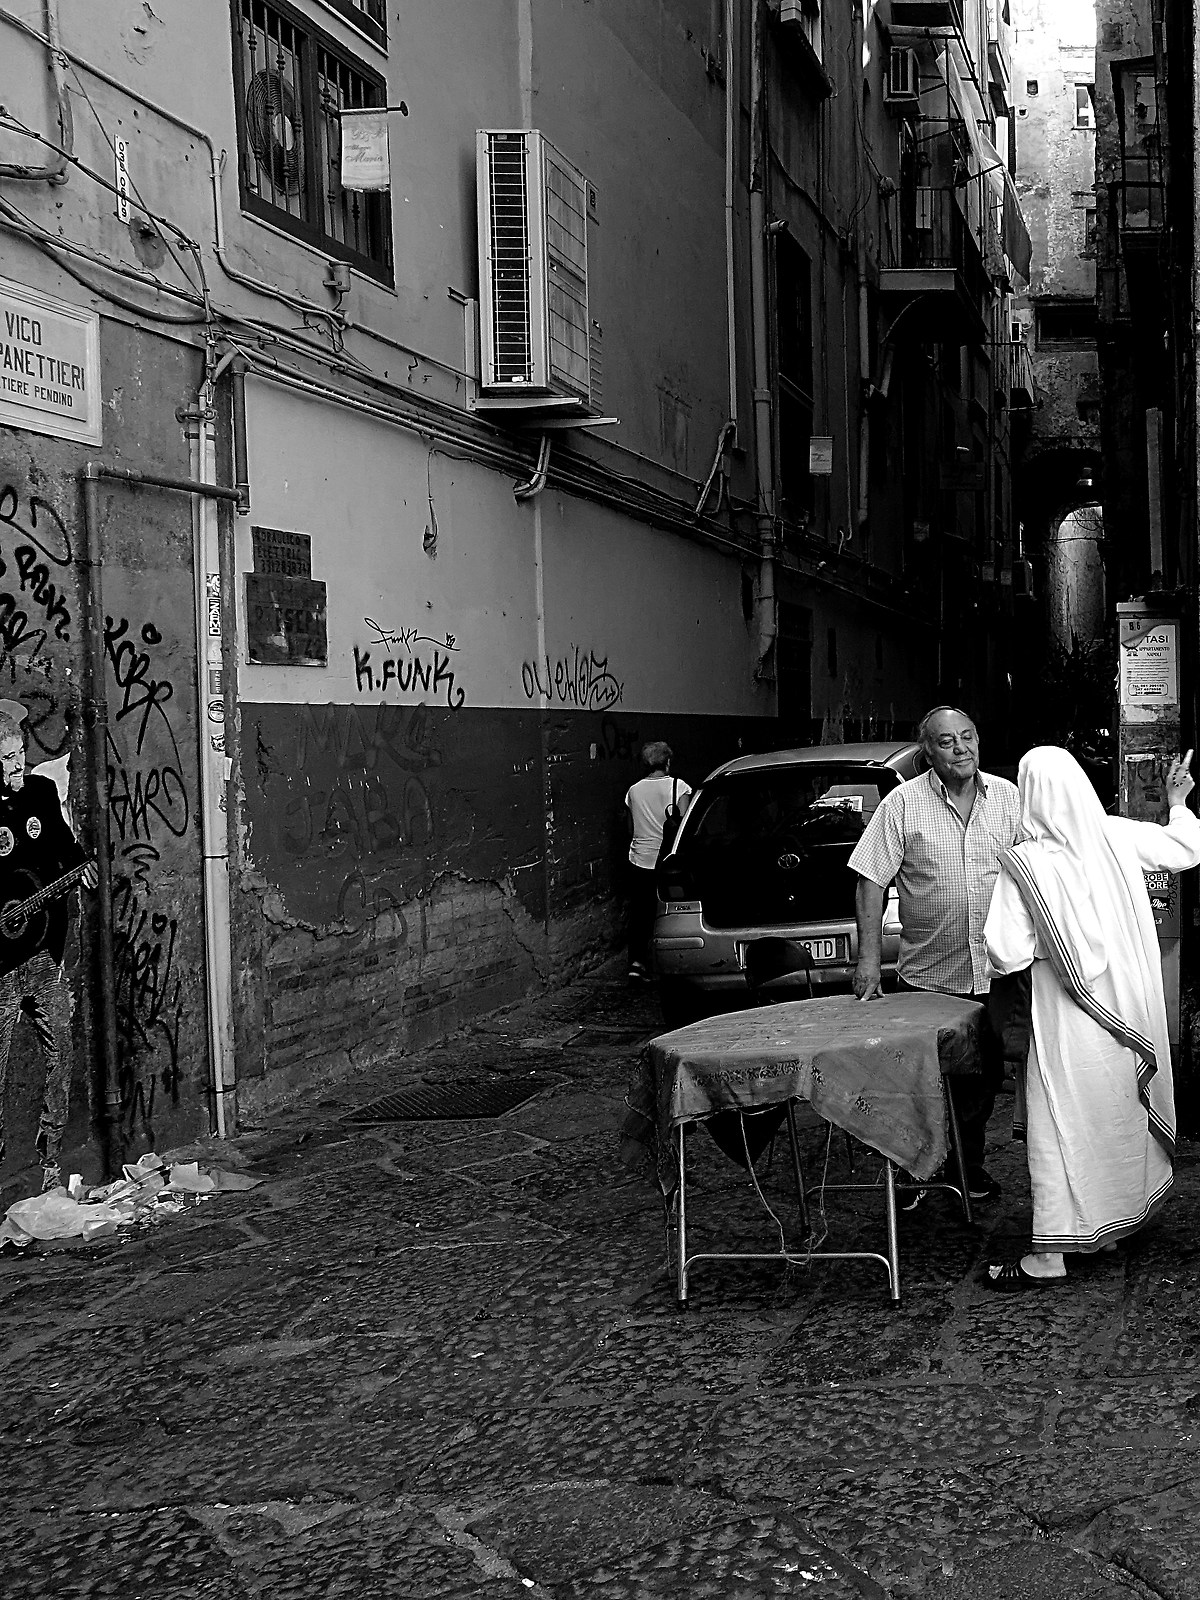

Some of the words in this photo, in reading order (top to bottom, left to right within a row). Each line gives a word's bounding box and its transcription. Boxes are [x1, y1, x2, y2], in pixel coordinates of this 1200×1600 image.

[4, 310, 42, 346] VICO
[0, 375, 29, 397] TIERE
[34, 385, 73, 408] PENDINO
[1145, 635, 1169, 644] TASI
[353, 646, 465, 711] K.FUNK
[1146, 873, 1169, 881] ROBE
[803, 940, 834, 958] 8TD
